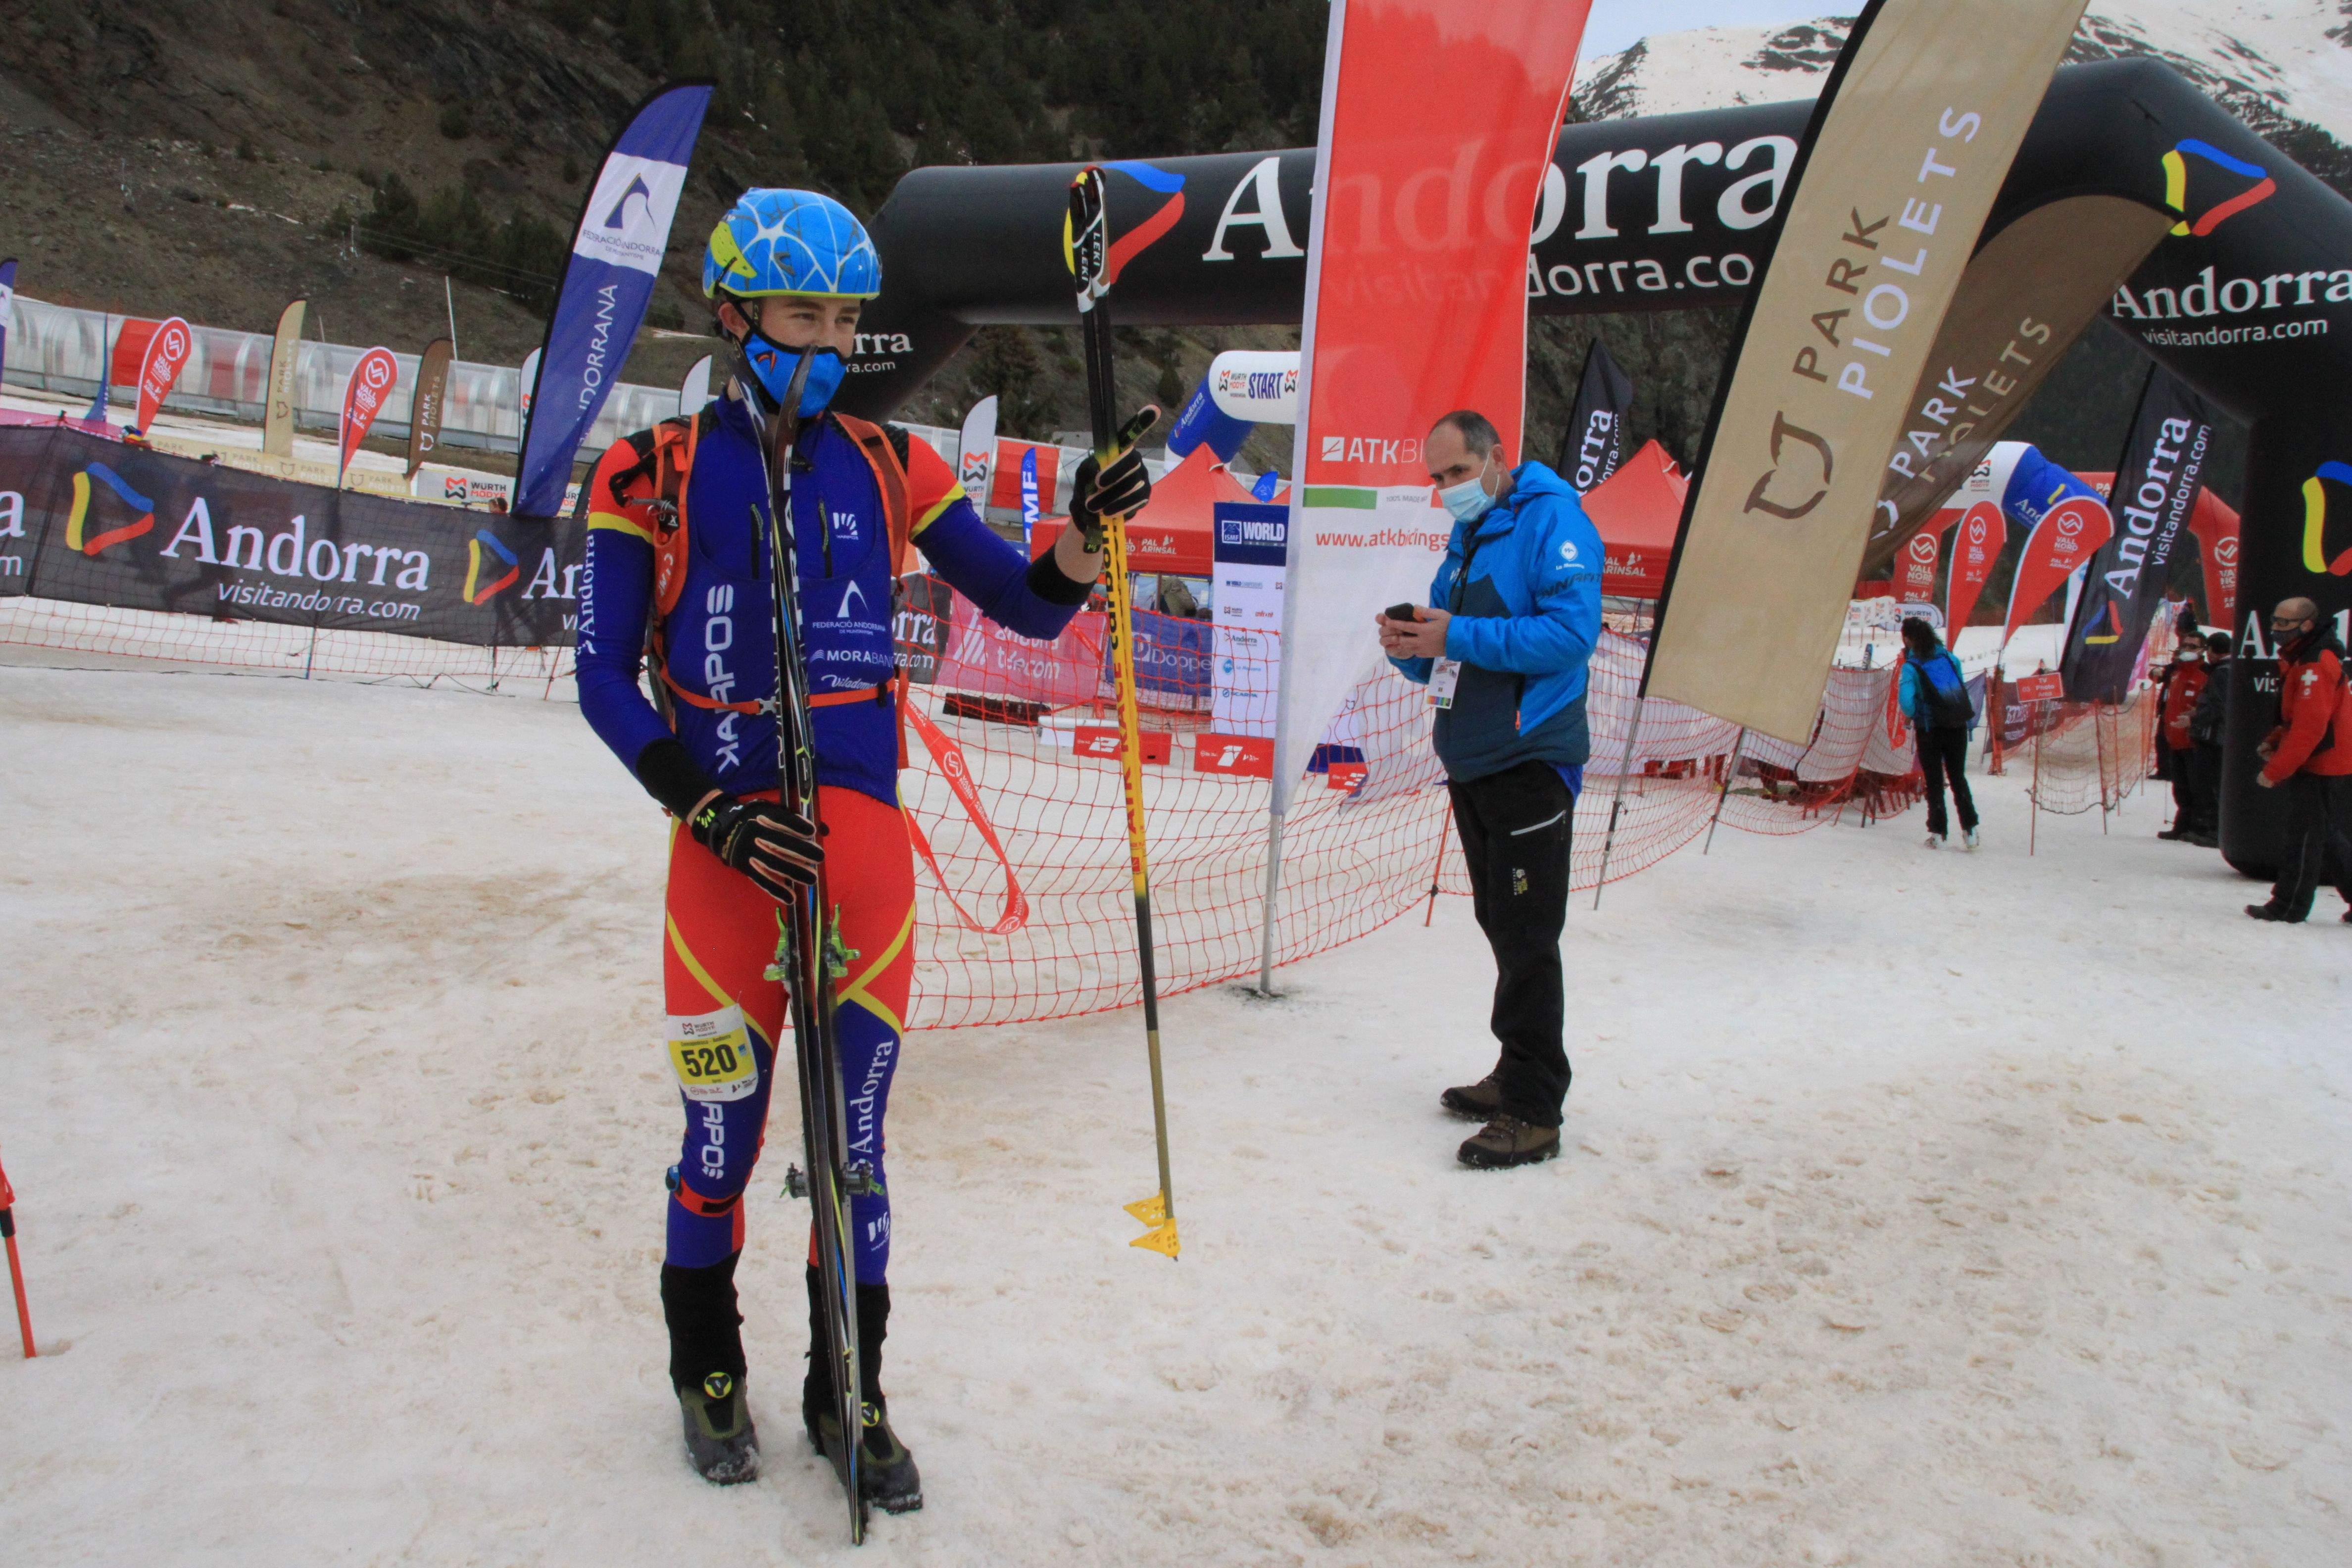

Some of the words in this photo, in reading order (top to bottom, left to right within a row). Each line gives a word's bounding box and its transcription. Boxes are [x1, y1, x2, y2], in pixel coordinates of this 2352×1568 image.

[1836, 106, 1980, 399] PIOLETS
[1792, 207, 1890, 384] PARK
[2112, 265, 2352, 319] Andorra
[2142, 318, 2328, 346] visitandorra.com
[1248, 372, 1284, 399] START
[422, 394, 431, 426] PARK
[1889, 366, 1977, 479] PARK
[471, 482, 507, 492] WÜRTH
[2151, 424, 2212, 566] visitandorra.com
[2104, 417, 2192, 600] Andorra
[160, 496, 430, 591] Andorra
[1141, 545, 1176, 555] ARINSAL
[1142, 538, 1157, 546] PAL
[1243, 522, 1285, 541] WORLD
[579, 534, 595, 637] Andorra
[1101, 525, 1118, 650] carbon
[1907, 571, 1933, 582] NORD
[1909, 563, 1931, 574] VALL
[218, 580, 421, 621] visitandorra.com
[812, 619, 853, 630] FEDERACIÓ
[1231, 635, 1257, 643] Andorra
[705, 584, 740, 774] KARPOS
[1114, 662, 1128, 752] RACE
[1217, 745, 1244, 767] 1
[1124, 767, 1137, 834] AIR
[681, 1044, 737, 1078] 520
[849, 1039, 894, 1155] Andorra
